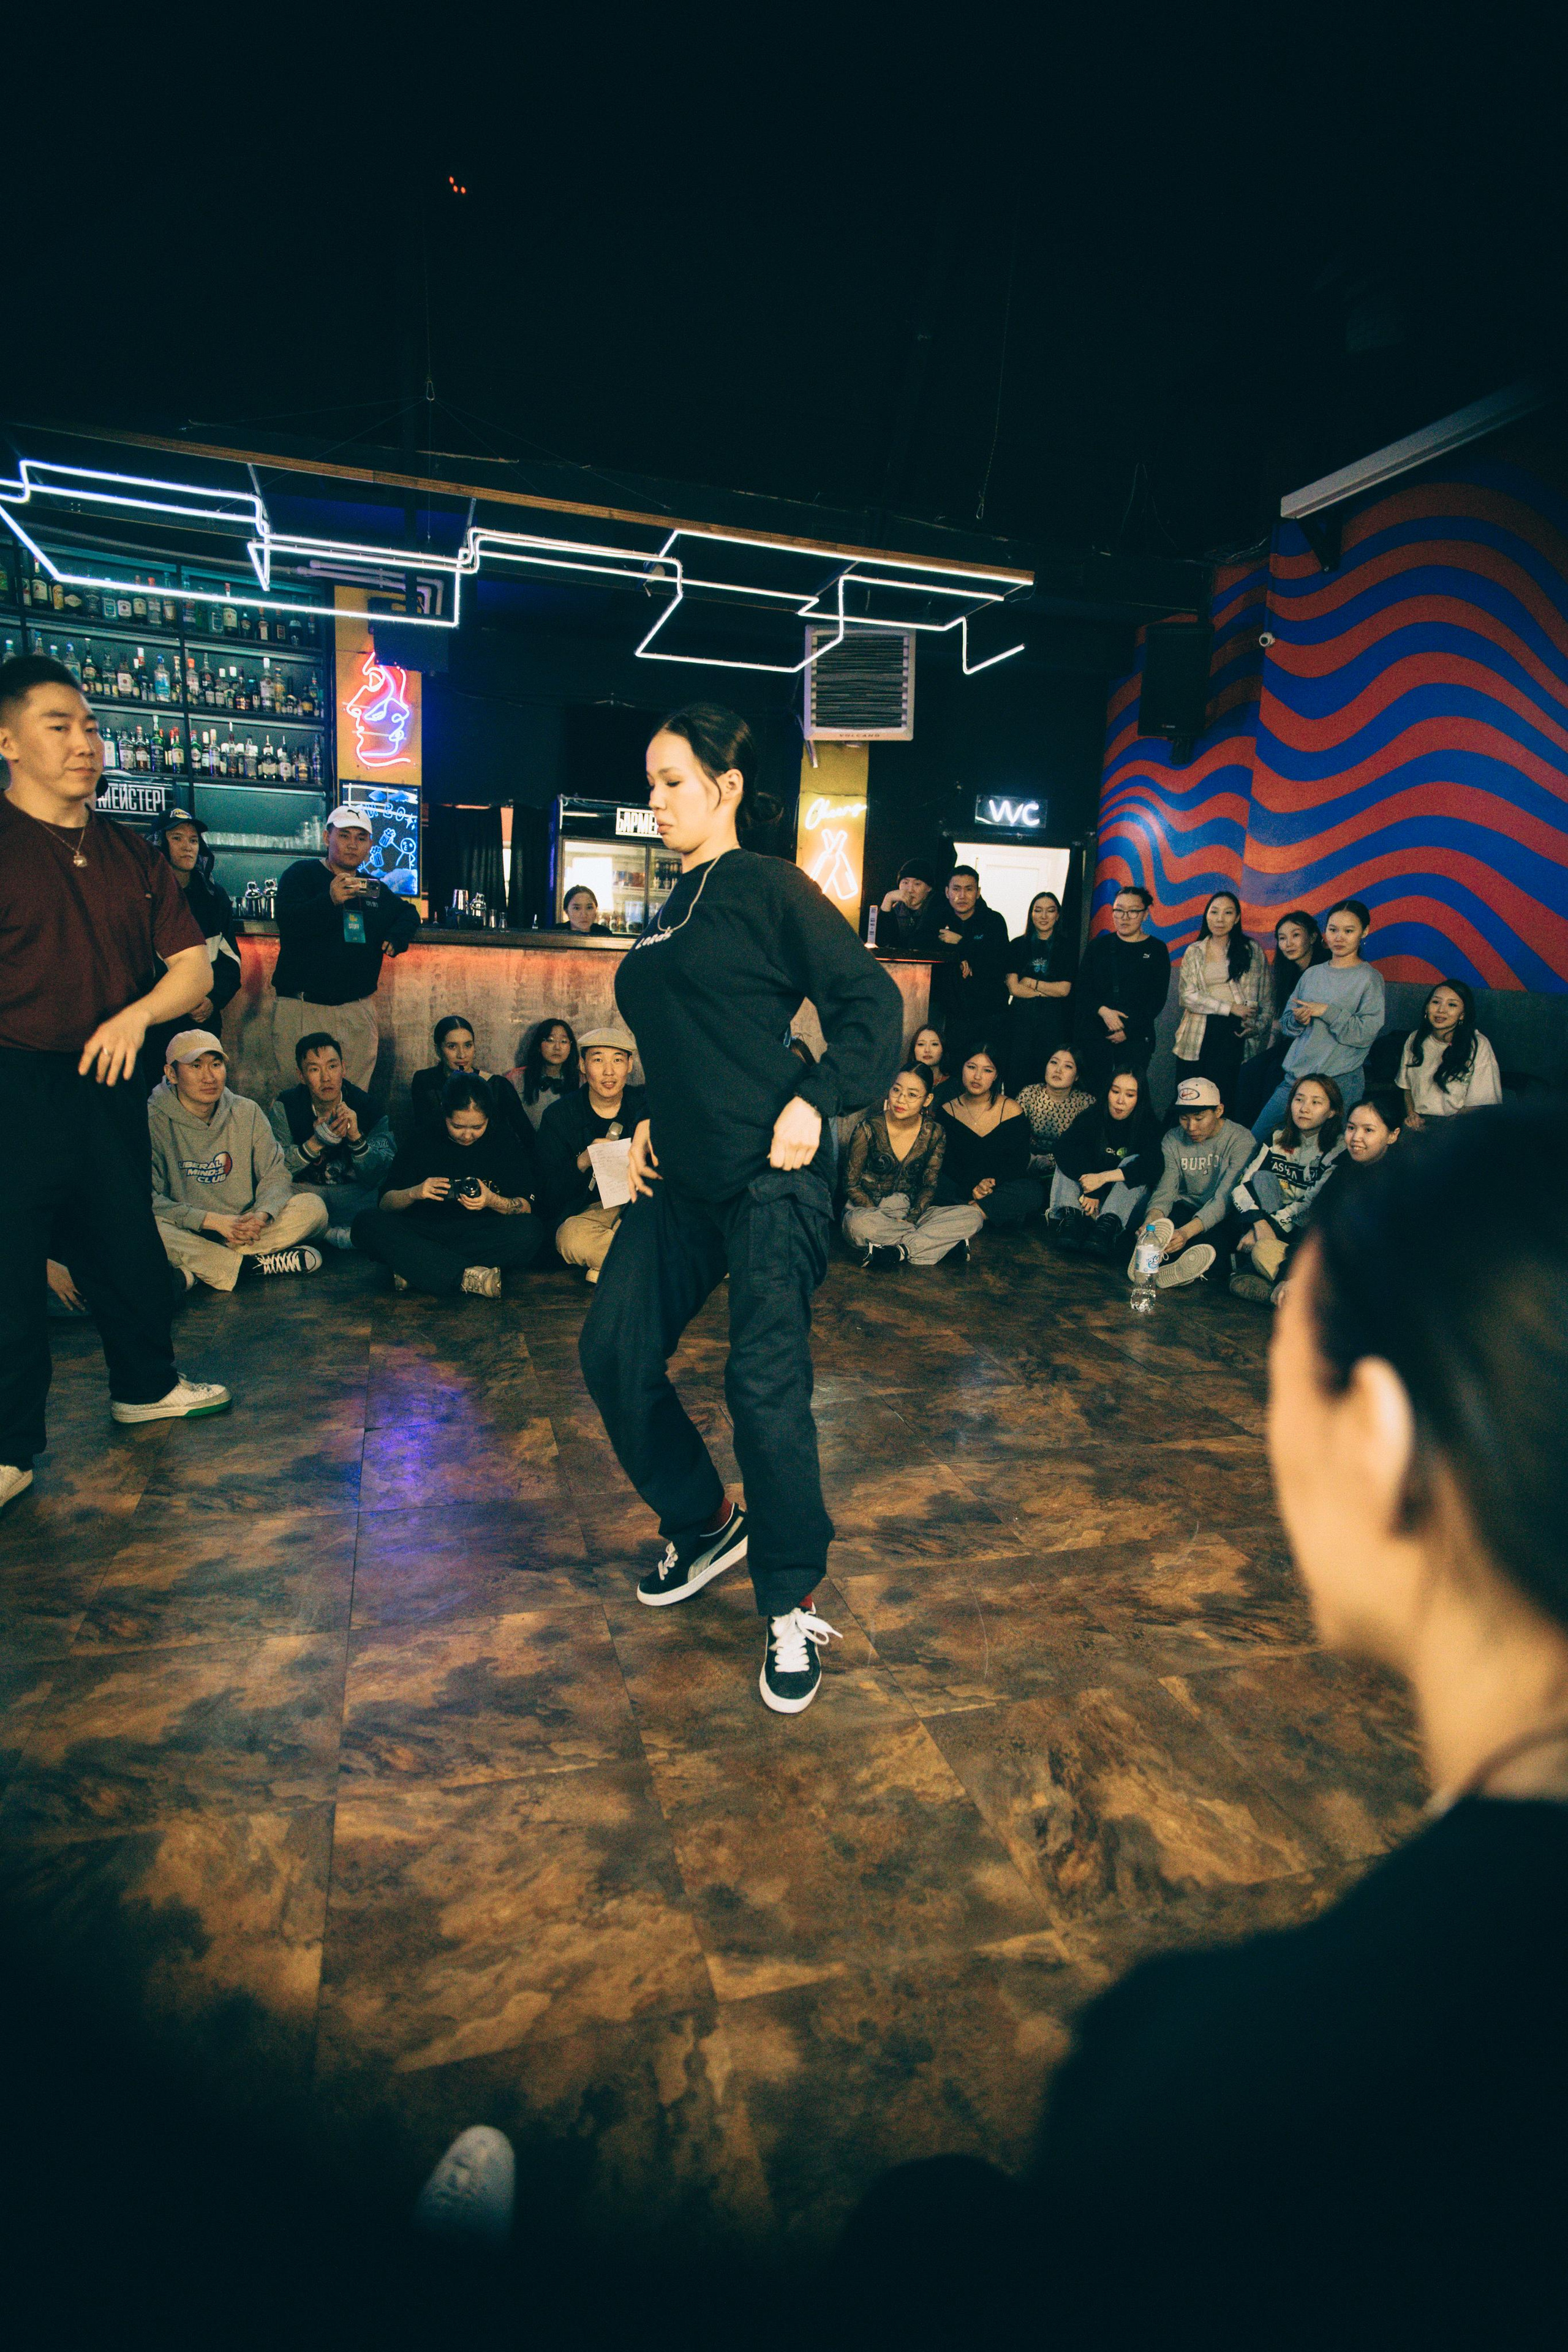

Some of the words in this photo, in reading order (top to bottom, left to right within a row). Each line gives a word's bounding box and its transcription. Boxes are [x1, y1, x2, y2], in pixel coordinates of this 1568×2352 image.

[97, 784, 162, 812] МЕЙСТЕР
[616, 811, 659, 834] БАРМЕ
[989, 799, 1040, 826] WC
[197, 1174, 226, 1184] CLUB
